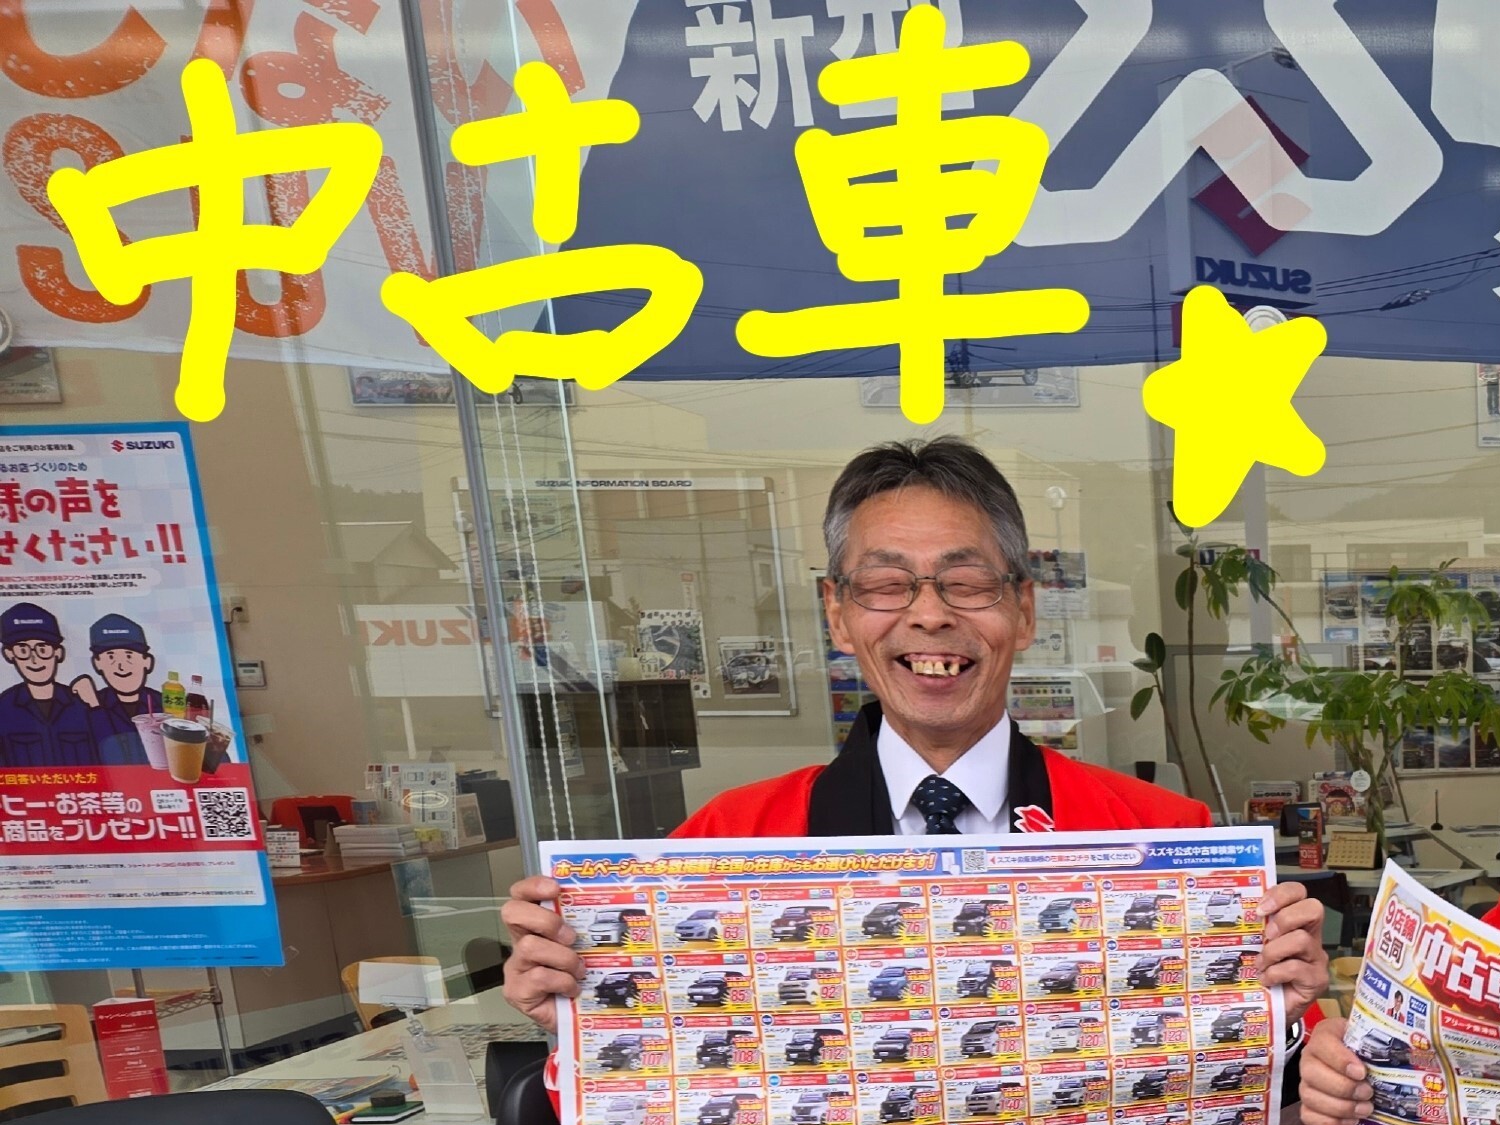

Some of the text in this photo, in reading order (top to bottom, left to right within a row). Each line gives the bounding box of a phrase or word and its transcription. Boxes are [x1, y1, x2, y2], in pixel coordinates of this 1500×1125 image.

[126, 440, 175, 450] SUZUKI
[164, 695, 184, 706] お茶
[0, 792, 142, 817] ヒー・お茶等の
[0, 816, 197, 842] 商品をプレゼント!!
[1384, 903, 1419, 943] 9店舗
[1379, 930, 1404, 967] 合同
